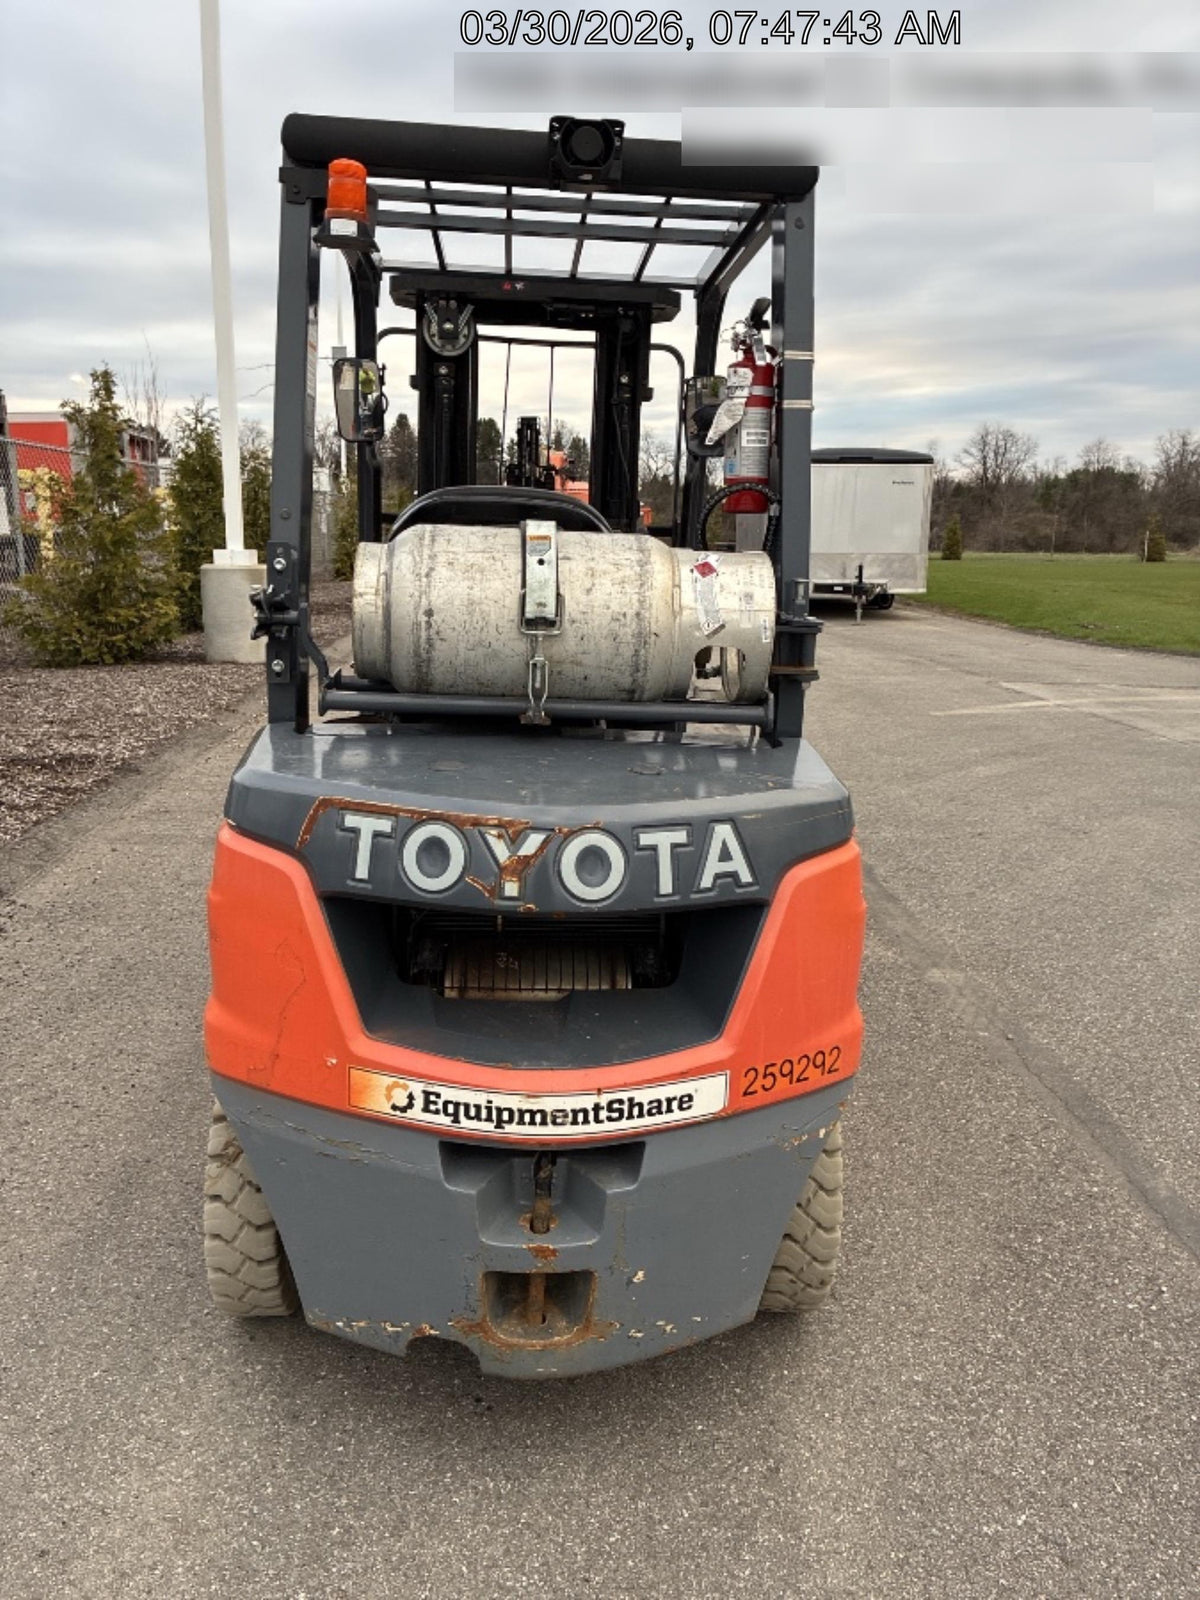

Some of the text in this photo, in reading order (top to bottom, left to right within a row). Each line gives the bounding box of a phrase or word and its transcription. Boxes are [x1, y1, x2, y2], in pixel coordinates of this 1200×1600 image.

[339, 813, 756, 902] TOYOTA
[742, 1045, 842, 1097] 259292
[421, 1089, 694, 1130] EquipmentShare
